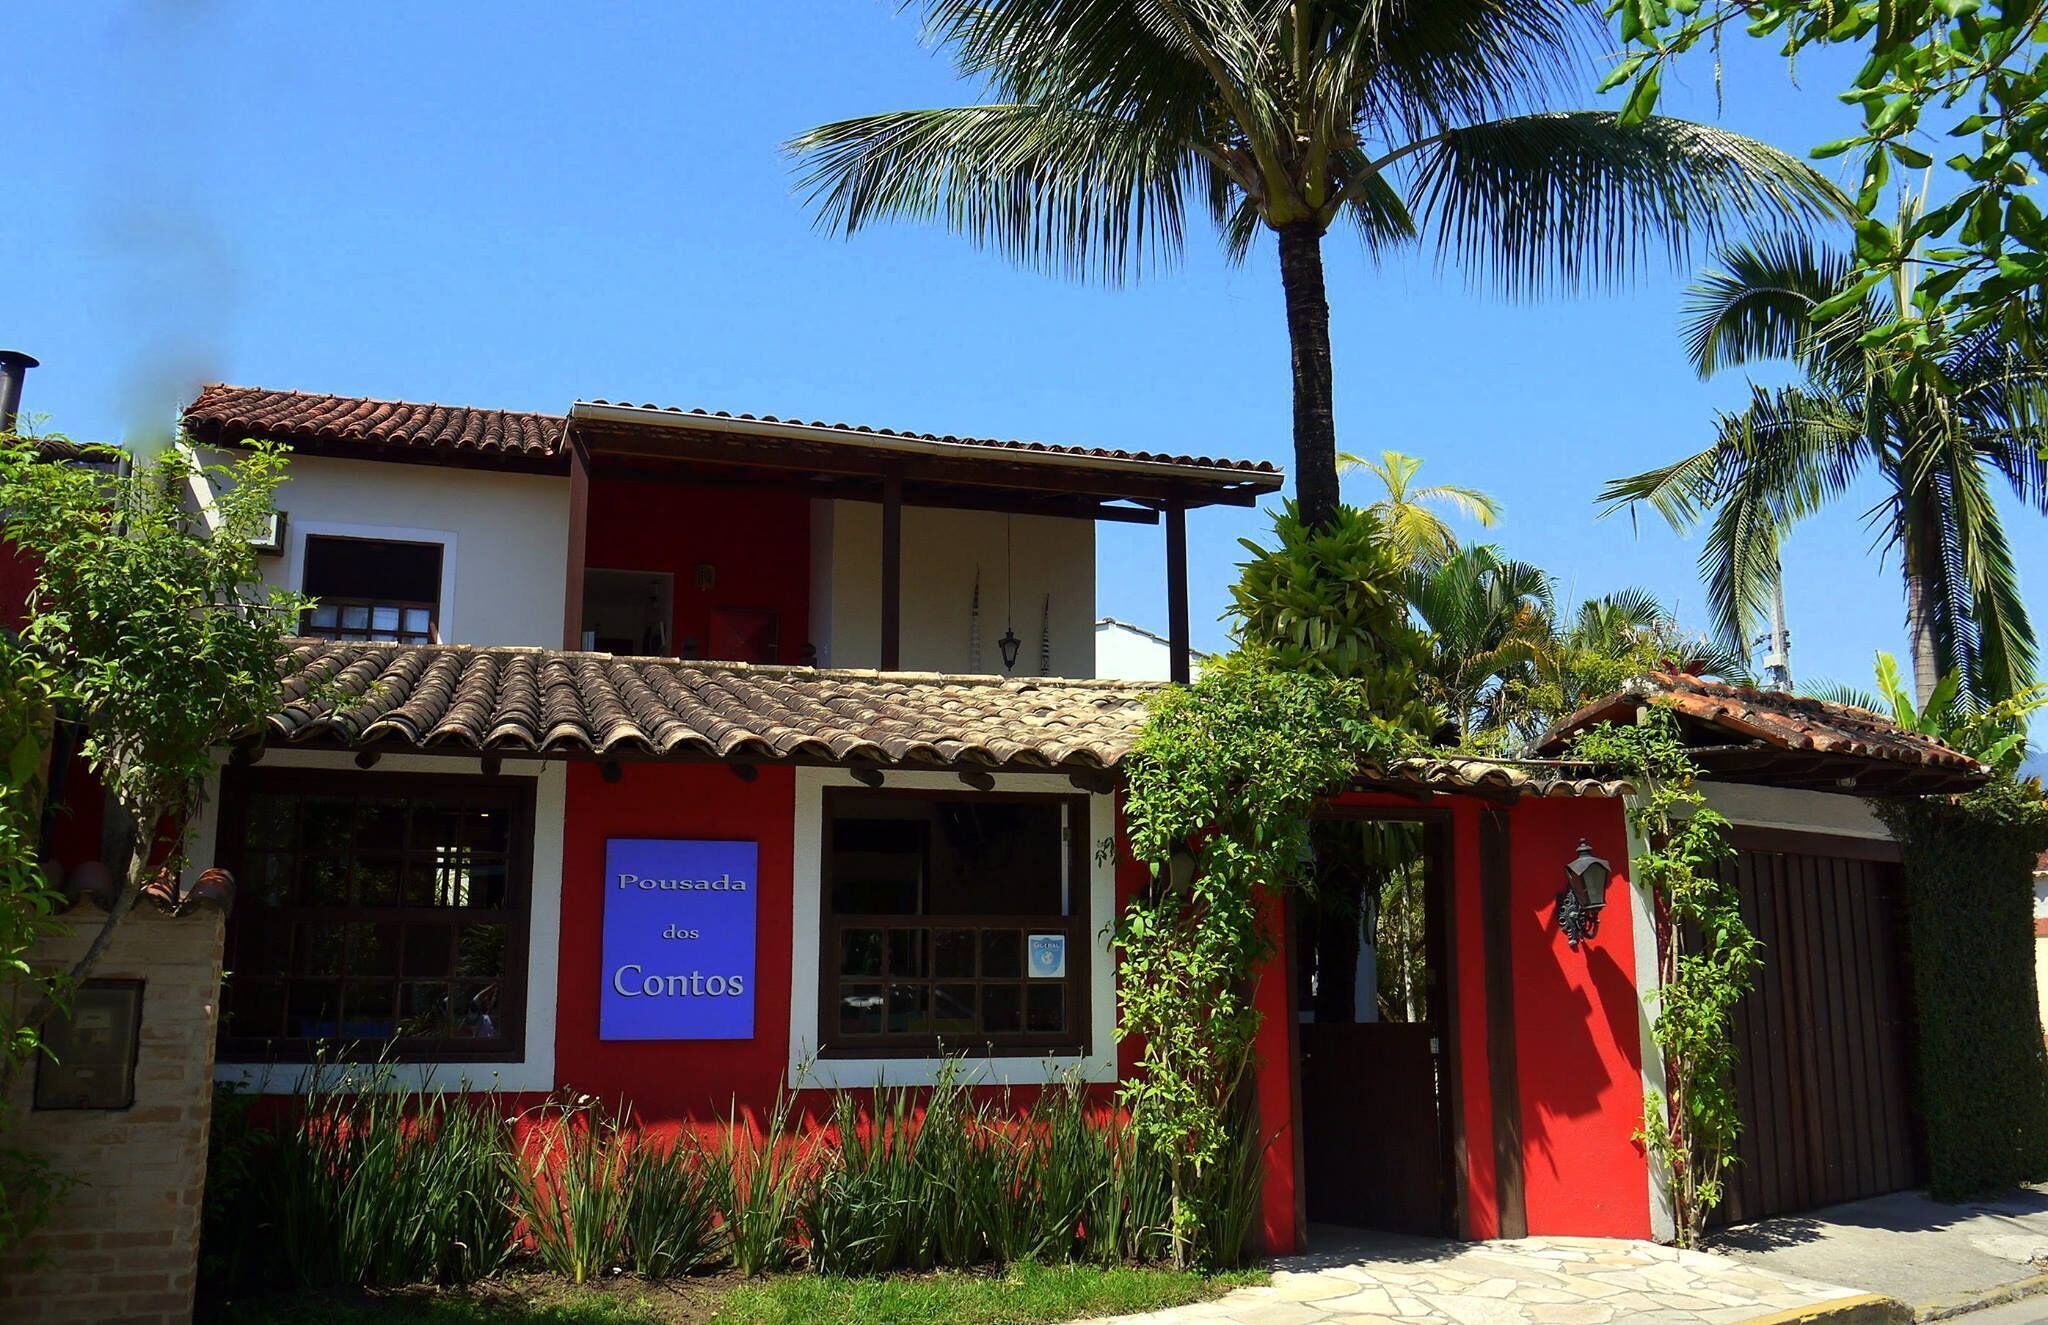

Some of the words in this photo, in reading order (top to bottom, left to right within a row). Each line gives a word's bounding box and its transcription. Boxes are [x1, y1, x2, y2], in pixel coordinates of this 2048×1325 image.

[618, 873, 747, 891] Pousada
[662, 923, 700, 940] dos
[614, 964, 744, 997] Contos
